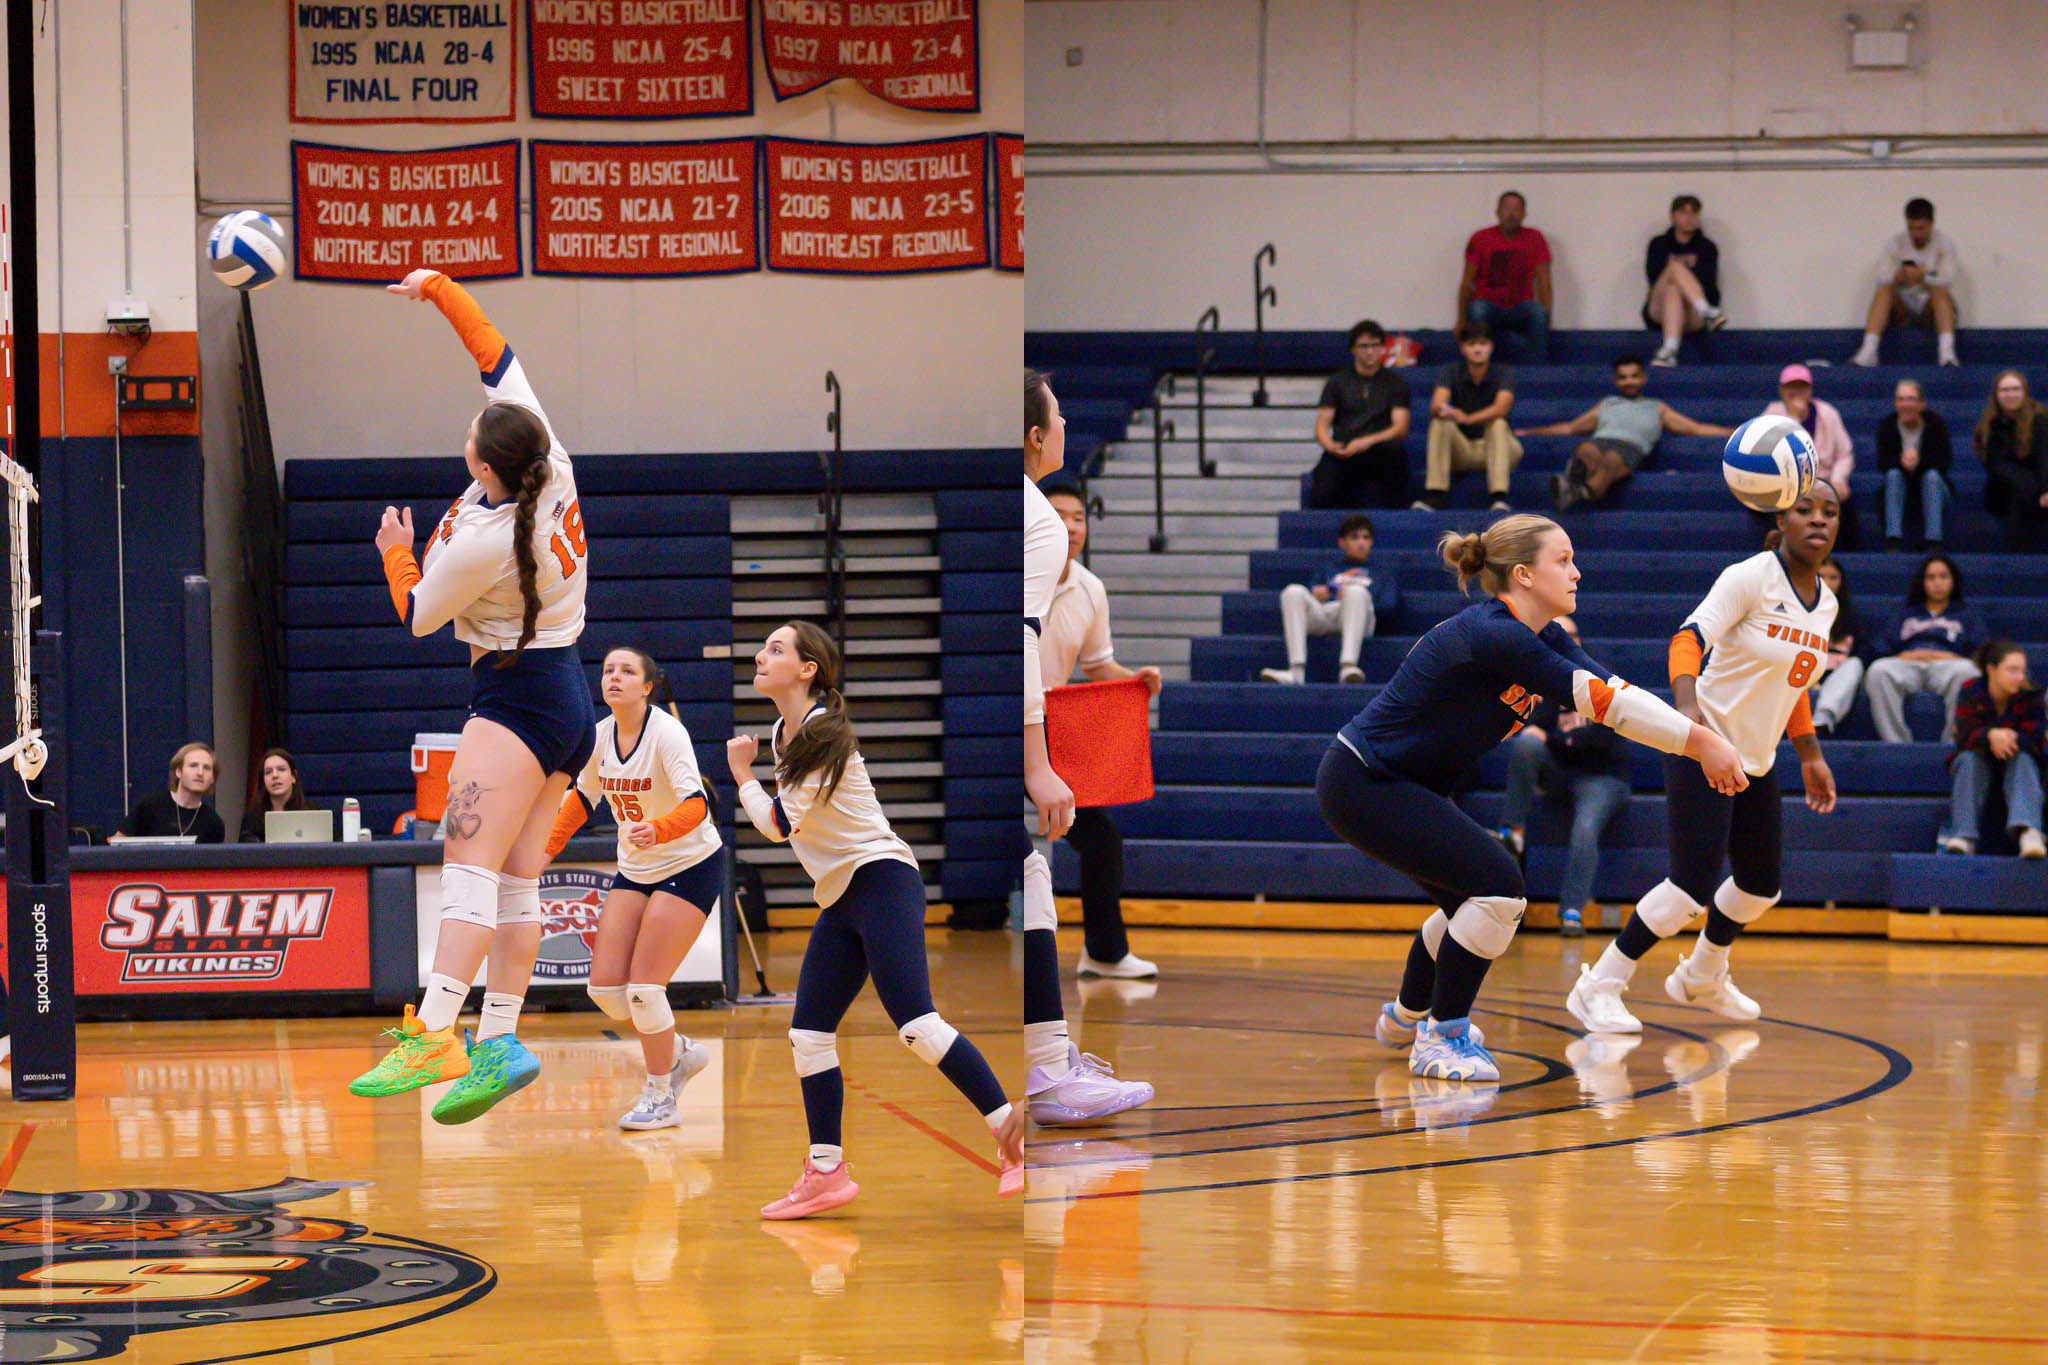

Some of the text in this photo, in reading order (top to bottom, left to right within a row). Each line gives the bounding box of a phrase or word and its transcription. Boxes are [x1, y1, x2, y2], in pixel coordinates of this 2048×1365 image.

[299, 3, 507, 29] WOMEN'S BASKETBALL
[536, 0, 743, 25] WOMEN'S BASKETBALL
[766, 0, 970, 26] WOMEN'S BASKETBALL
[312, 41, 494, 65] 1995 NCAA 28-4
[547, 37, 733, 64] 1996 NCAA 25-4
[774, 34, 963, 65] 1997 NCAA 23-4
[327, 78, 478, 102] FINAL FOUR
[557, 75, 726, 103] SWEET SIXTEEN
[883, 72, 972, 98] REGIONAL
[307, 161, 502, 191] WOMEN'S BASKETBALL
[550, 158, 740, 186] WOMEN'S BASKETBALL
[780, 154, 970, 183] WOMEN'S BASKETBALL
[317, 199, 498, 227] 2004 NCAA 24-4
[550, 194, 740, 222] 2005 NCAA 21-7
[779, 189, 975, 221] 2006 NCAA 23-5
[313, 236, 502, 265] NORTHEAST REGIONAL
[549, 231, 743, 258] NORTHEAST REGIONAL
[781, 228, 974, 259] NORTHEAST REGIONAL
[550, 498, 587, 580] 18
[1767, 623, 1828, 653] VIKIN
[1787, 650, 1818, 688] 8
[612, 794, 643, 822] 15
[566, 873, 597, 885] STATE
[32, 903, 48, 951] sports
[104, 886, 325, 945] SALEM
[153, 938, 279, 951] STATE
[132, 956, 276, 974] VIKINGS
